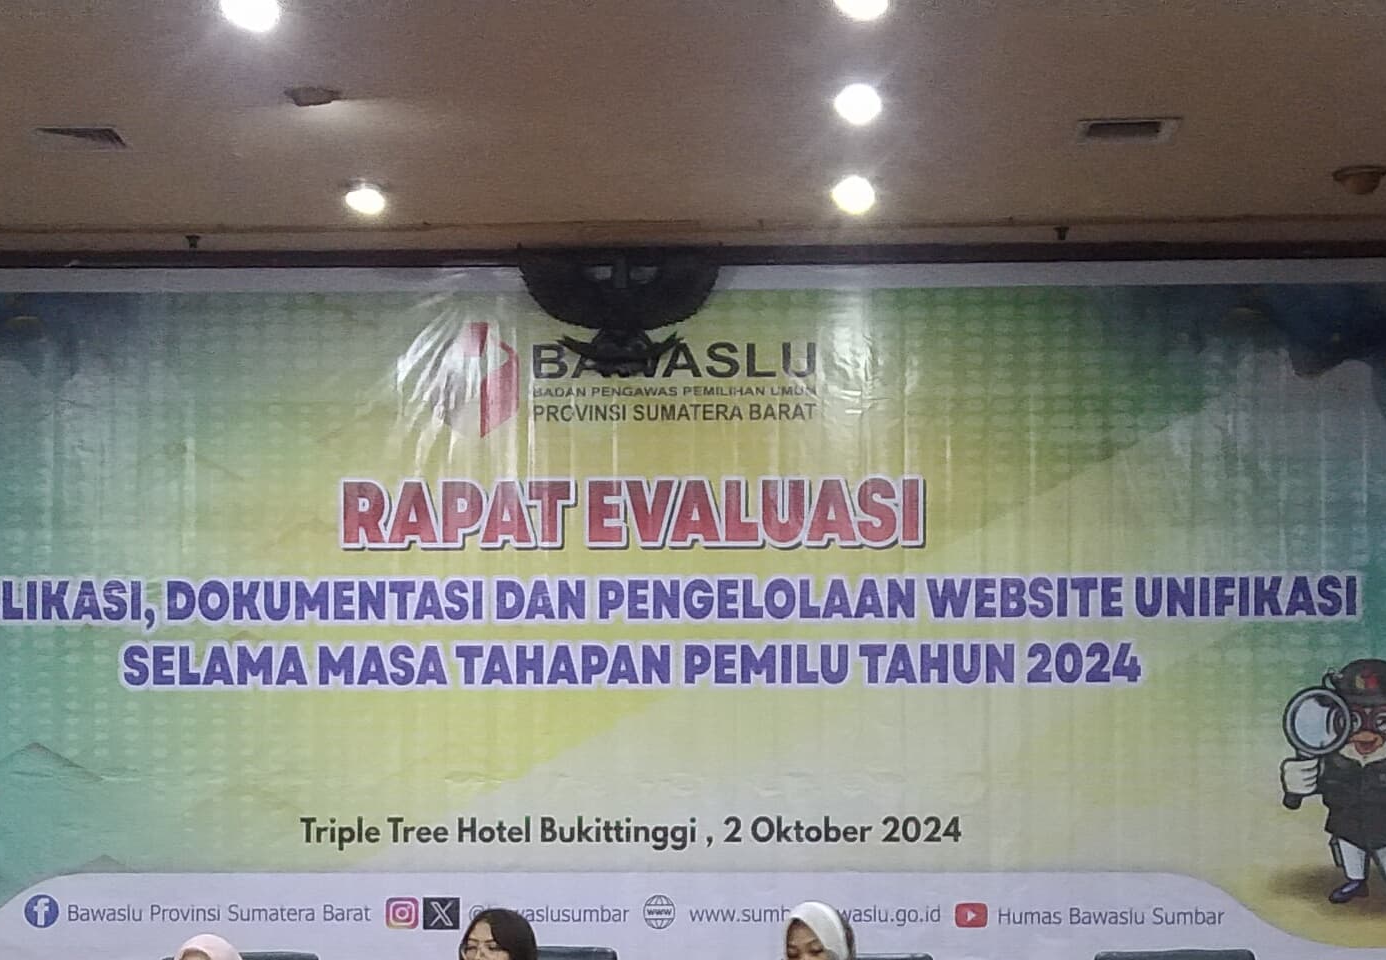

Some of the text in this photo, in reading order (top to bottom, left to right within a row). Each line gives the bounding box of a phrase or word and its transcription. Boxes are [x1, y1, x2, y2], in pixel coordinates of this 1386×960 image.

[533, 385, 586, 398] BADAN
[592, 386, 677, 397] PENGAWAS
[683, 385, 765, 397] PEMILIHAN
[533, 402, 817, 422] PROVINSI SUMATERA BARAT
[341, 477, 926, 548] RAPAT EVALUASI
[168, 579, 483, 620] DOKUMENTASI
[495, 578, 585, 620] DAN
[598, 578, 915, 620] PENGELOLAAN
[925, 576, 1123, 619] WEBSITE
[1134, 575, 1358, 618] UNIFIKASI
[123, 641, 1143, 687] SELAMA MASA TAHAPAN PEMILU TAHUN 2024
[300, 815, 380, 851] Triple
[386, 816, 450, 844] Tree
[457, 815, 531, 844] Hotel
[540, 815, 696, 851] Bukittinggi
[723, 815, 742, 843] 2
[750, 815, 873, 843] Oktober
[881, 815, 962, 843] 2024
[68, 903, 372, 922] Bawaslu Provinsi Sumatera Barat
[998, 906, 1226, 926] Humas Bawaslu Sumbar
